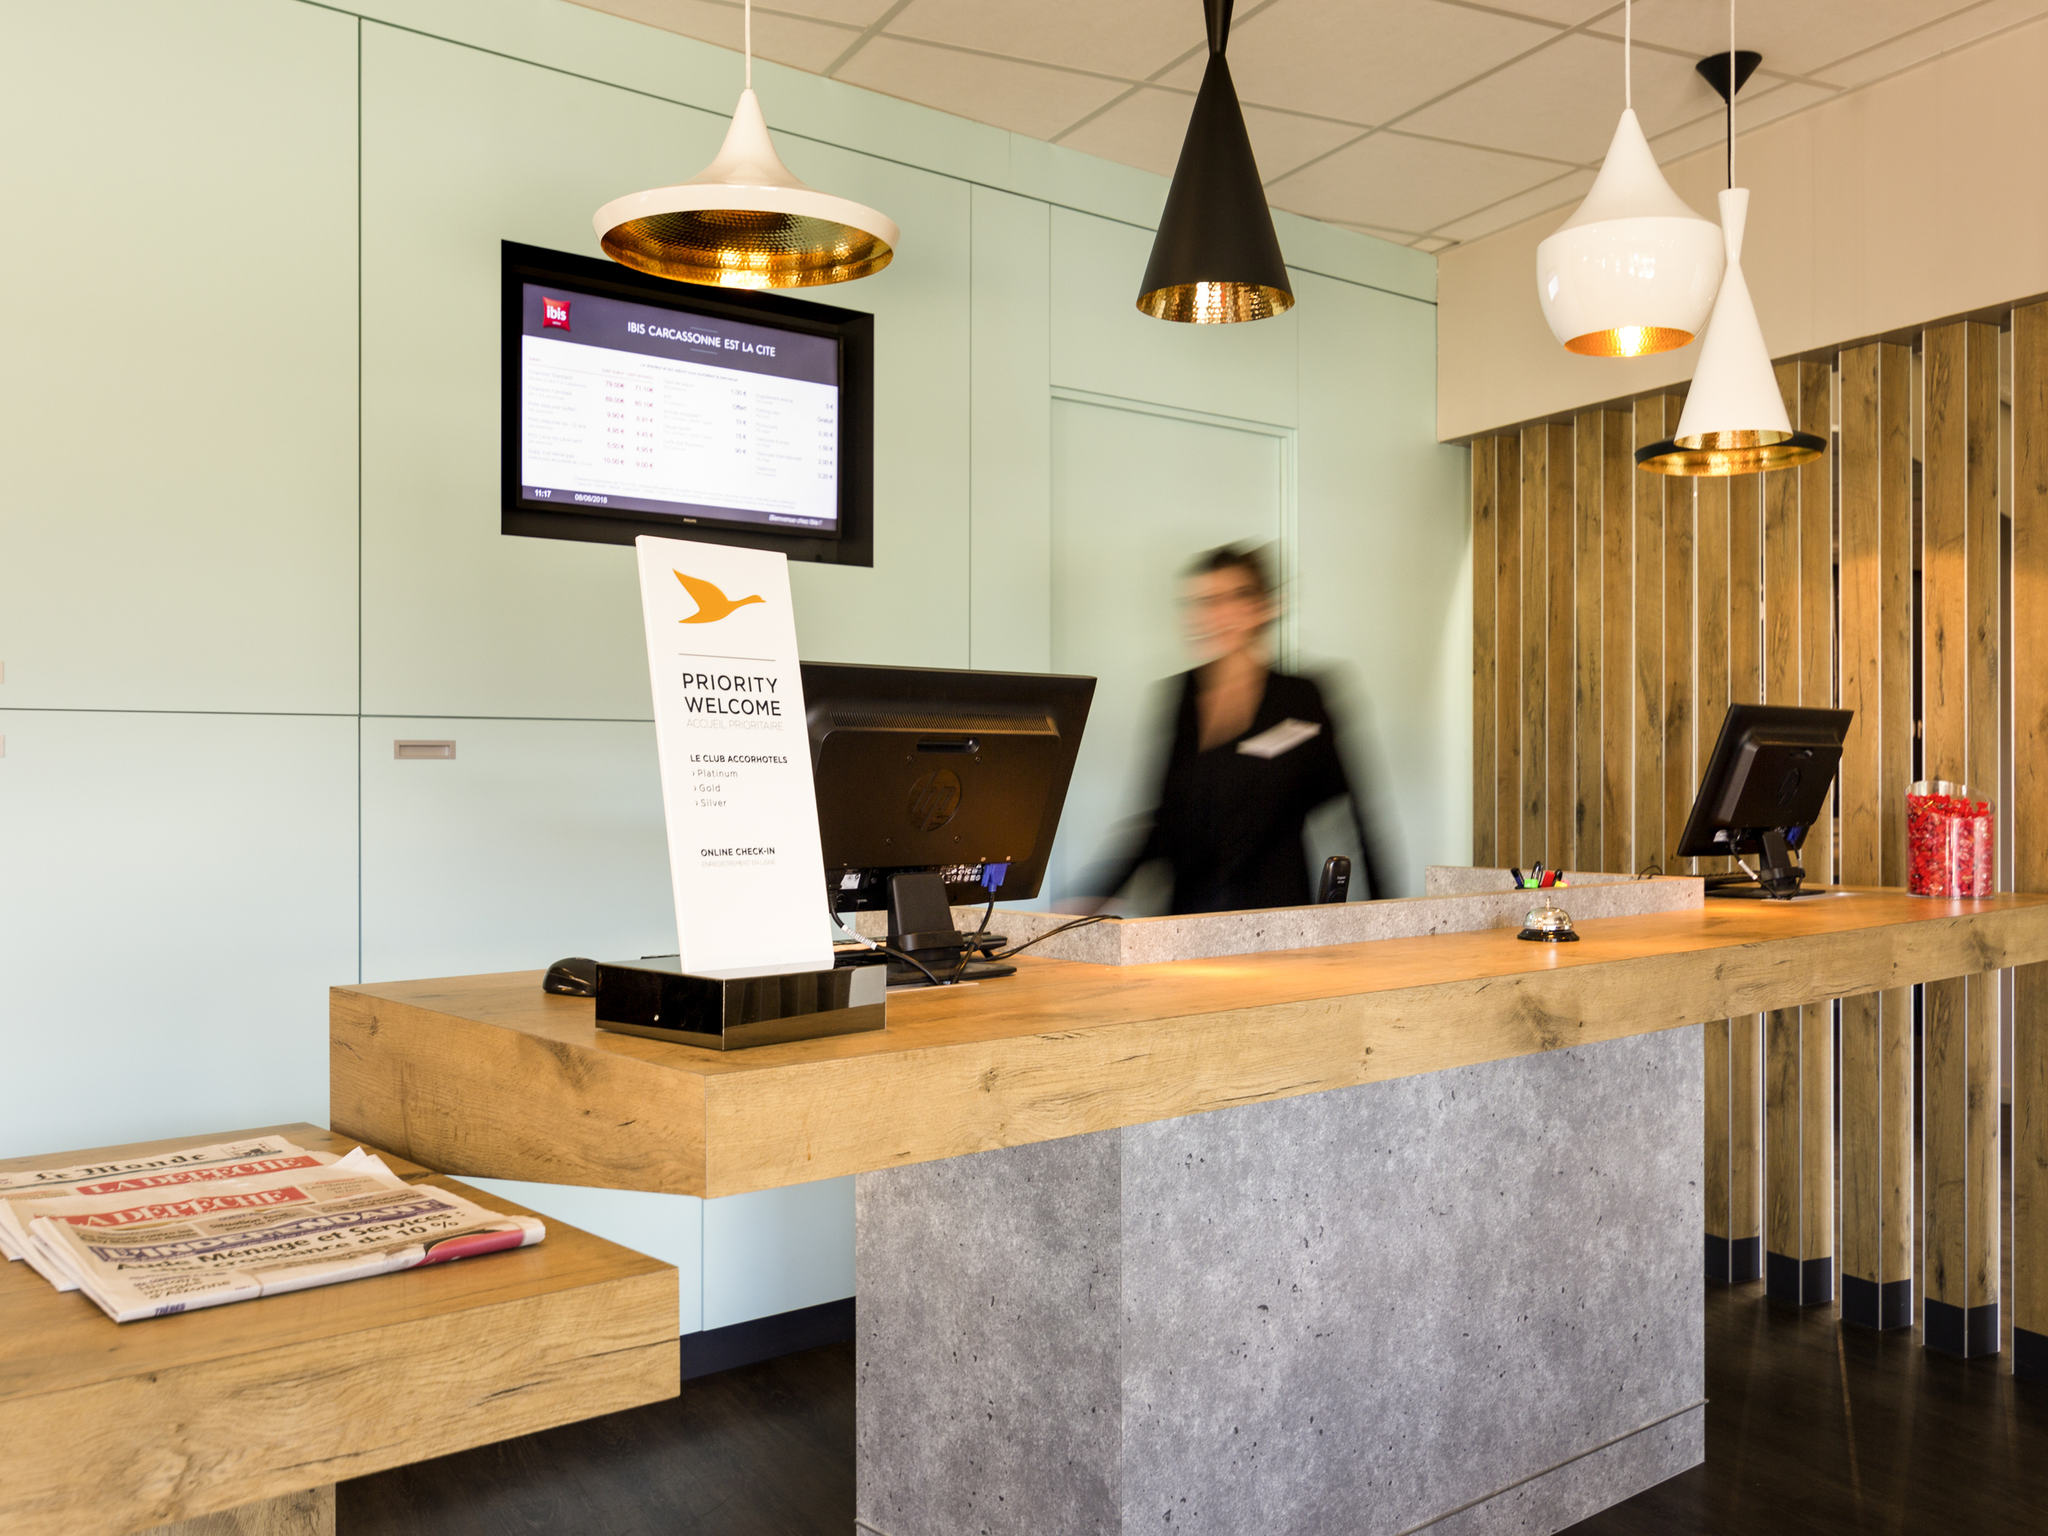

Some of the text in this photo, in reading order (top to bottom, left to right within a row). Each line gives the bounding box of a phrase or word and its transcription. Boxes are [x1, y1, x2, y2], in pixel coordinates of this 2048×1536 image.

[546, 305, 567, 321] ibis
[628, 321, 777, 358] IBIS CARCASSONNE EST LA CITE
[534, 488, 552, 498] 11:17
[682, 673, 778, 694] PRIORITY
[684, 696, 782, 717] WELCOME
[690, 754, 788, 764] LE CLUB ACCORHOTELS
[697, 769, 738, 778] Platinum
[699, 783, 721, 792] Gold
[701, 798, 727, 807] Silver
[701, 847, 775, 857] ONLINE CHECK-IN
[34, 1153, 209, 1181] Le Monde
[198, 1238, 311, 1263] Ménage
[317, 1231, 347, 1242] et
[349, 1213, 453, 1237] Services
[358, 1235, 390, 1244] de
[395, 1226, 428, 1237] 10
